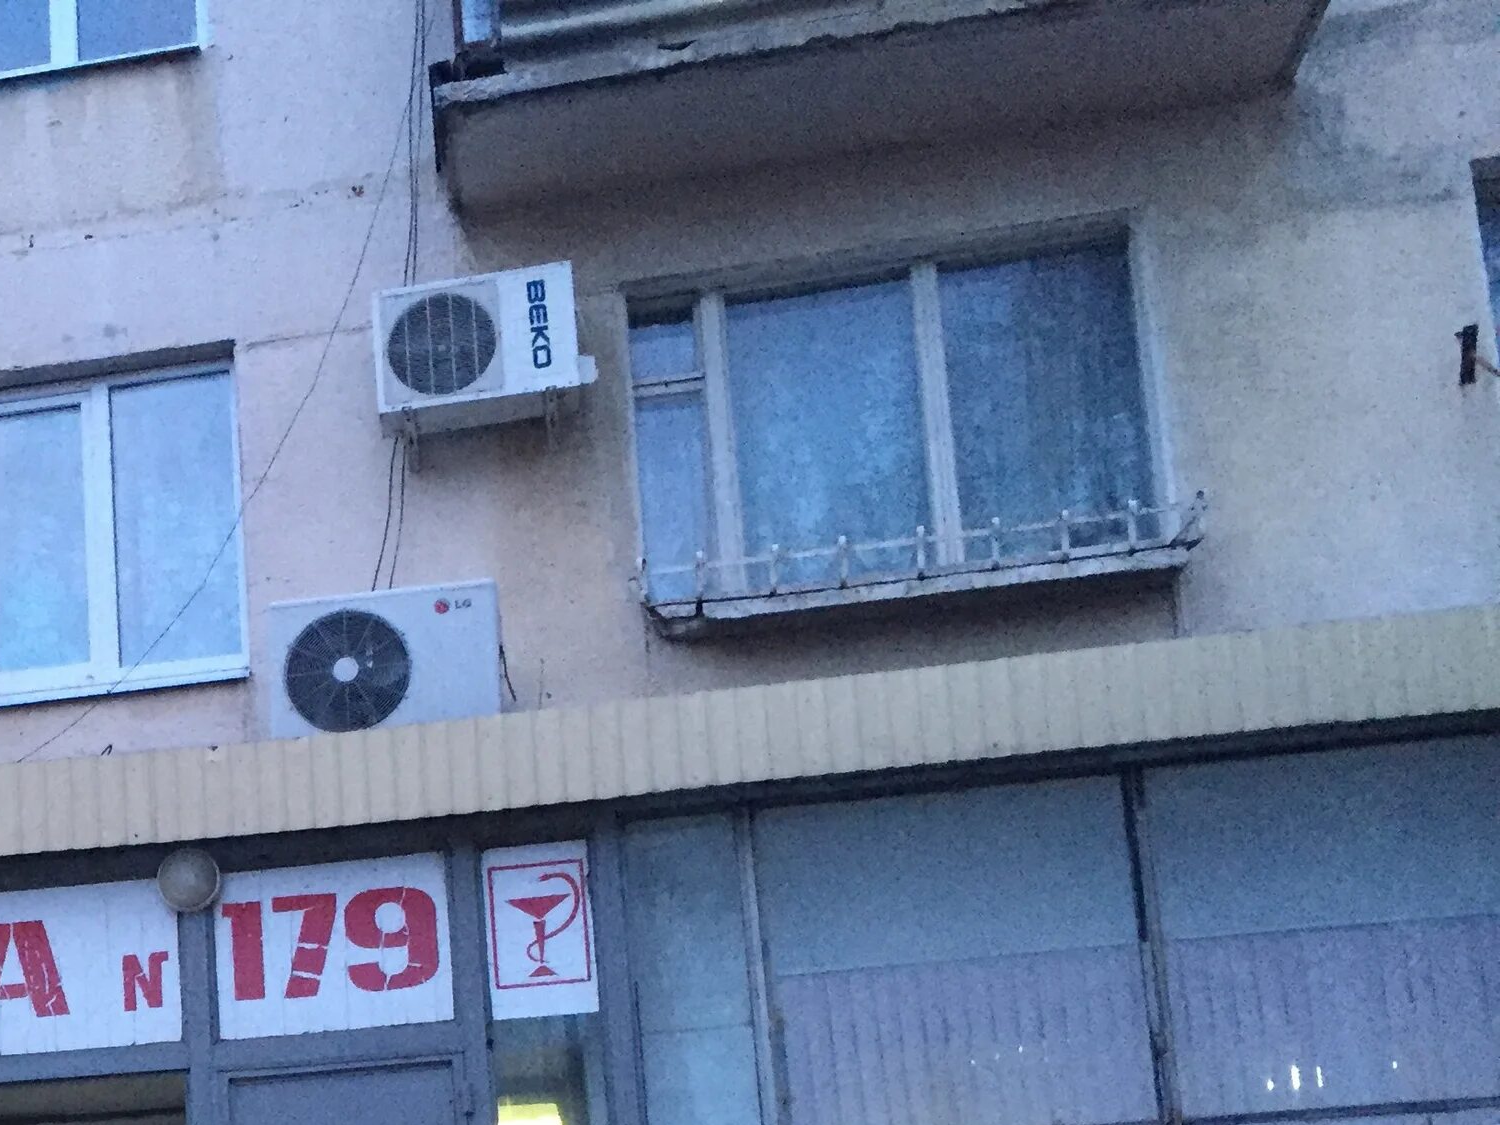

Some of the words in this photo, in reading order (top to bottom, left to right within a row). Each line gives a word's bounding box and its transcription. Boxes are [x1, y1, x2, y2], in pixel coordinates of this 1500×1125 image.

[525, 278, 553, 370] BEKO
[454, 598, 473, 610] LG
[222, 886, 441, 1001] 179
